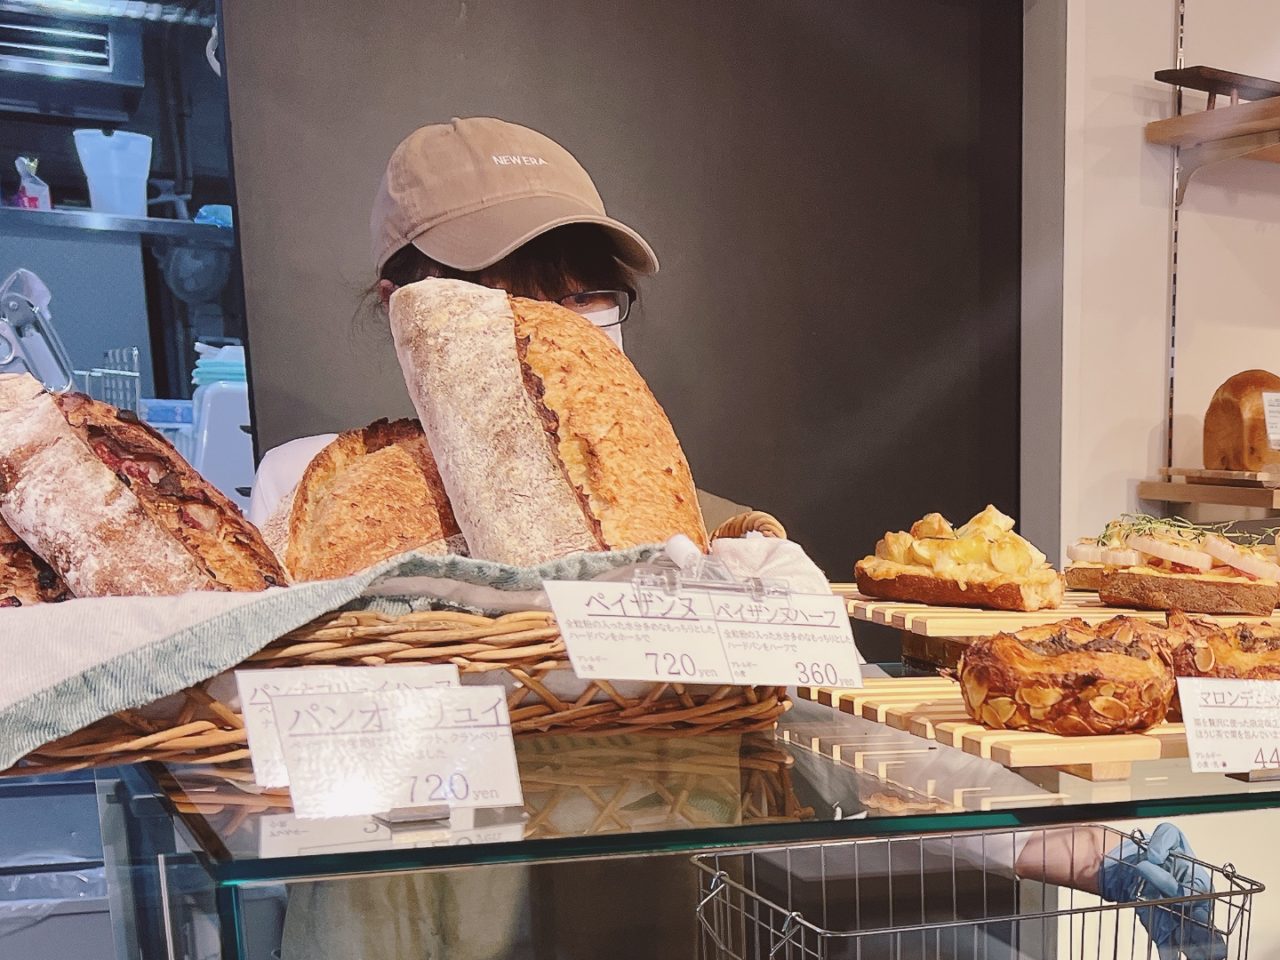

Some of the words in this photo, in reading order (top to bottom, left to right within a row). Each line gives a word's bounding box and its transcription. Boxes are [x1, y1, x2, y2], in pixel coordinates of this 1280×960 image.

[492, 154, 521, 166] NEW
[521, 155, 548, 166] ERA
[585, 592, 697, 618] ペイザンヌ
[717, 602, 836, 627] ペイザンヌハーフ
[645, 652, 697, 677] 720
[795, 661, 838, 686] 360
[407, 772, 469, 803] 720
[473, 787, 499, 802] yen
